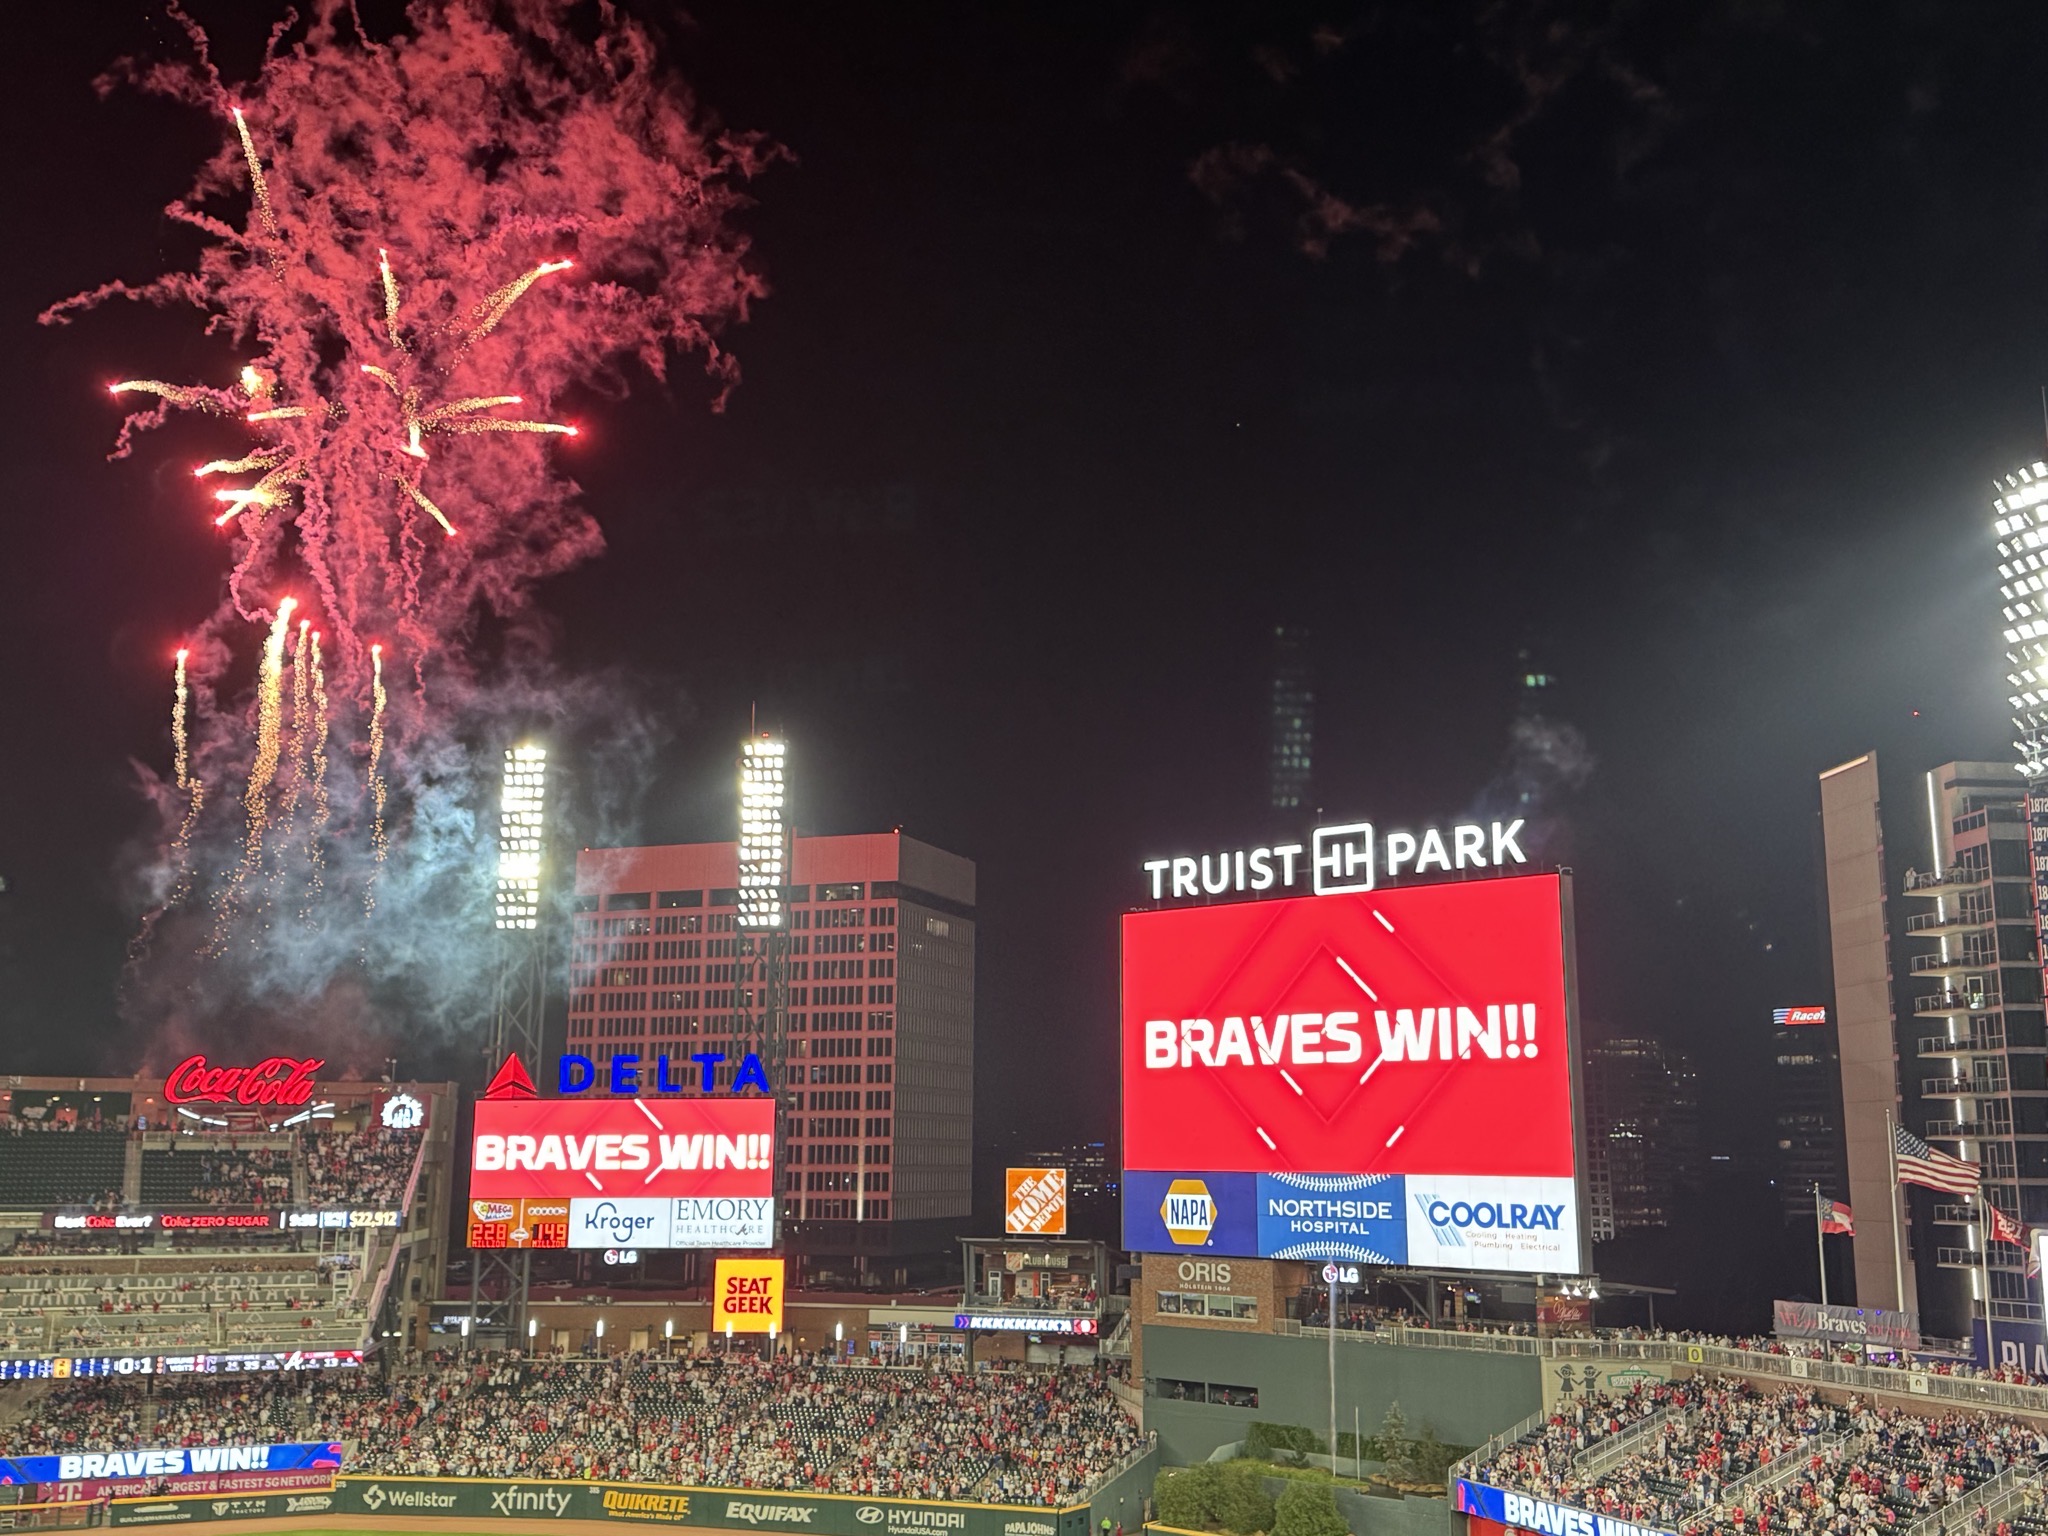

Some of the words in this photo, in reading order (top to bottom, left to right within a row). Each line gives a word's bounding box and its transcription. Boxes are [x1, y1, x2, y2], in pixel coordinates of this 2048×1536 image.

[1144, 844, 1302, 899] TRUIST
[1387, 819, 1527, 876] PARK
[1145, 1011, 1361, 1069] BRAVES
[1374, 1003, 1539, 1063] WIN!!
[163, 1054, 325, 1105] Coca-Cola
[559, 1053, 770, 1093] DELTA
[475, 1134, 649, 1171] BRAVES
[659, 1134, 770, 1170] WIN!!
[1012, 1176, 1037, 1201] THE
[676, 1199, 769, 1221] EMORY
[1007, 1170, 1064, 1231] HOME
[1268, 1198, 1393, 1220] NORTHSIDE
[86, 1215, 115, 1228] Coke
[161, 1215, 191, 1227] Coke
[191, 1216, 226, 1227] ZERO
[227, 1216, 269, 1227] SUGAR
[585, 1202, 655, 1242] Kroger
[1029, 1193, 1064, 1231] DEPOT
[1169, 1198, 1209, 1226] NAPA
[1428, 1200, 1566, 1230] COOLRAY
[472, 1223, 507, 1240] 228
[538, 1223, 567, 1240] 149
[676, 1223, 764, 1235] HEALTHCARE
[1291, 1219, 1369, 1236] HOSPITAL
[1465, 1230, 1497, 1240] Cooling
[1505, 1232, 1538, 1242] Heating
[472, 1240, 506, 1248] MILLION
[532, 1240, 566, 1248] MILLION
[1474, 1241, 1513, 1250] Plumbing
[1521, 1242, 1560, 1252] Electrical
[619, 1251, 638, 1264] LG
[1178, 1261, 1231, 1283] ORIS
[1339, 1266, 1360, 1284] LG
[22, 1278, 90, 1306] HANK
[197, 1274, 310, 1303] TERRACE
[726, 1277, 772, 1295] SEAT
[723, 1296, 773, 1314] GEEK
[1817, 1311, 1867, 1335] Braves
[59, 1450, 185, 1480] BRAVES
[190, 1446, 270, 1472] WIN!!
[219, 1478, 262, 1490] FASTEST
[280, 1475, 331, 1486] NETWORK
[231, 1500, 266, 1509] TYM
[388, 1490, 456, 1509] Wellstar
[491, 1485, 572, 1517] xfinity
[603, 1490, 690, 1514] QUIKRETE
[726, 1501, 812, 1525] EQUIFAX
[888, 1509, 965, 1529] HYUNDAI
[1504, 1492, 1595, 1536] BRAVES
[888, 1525, 948, 1536] HyundaiUSA.com
